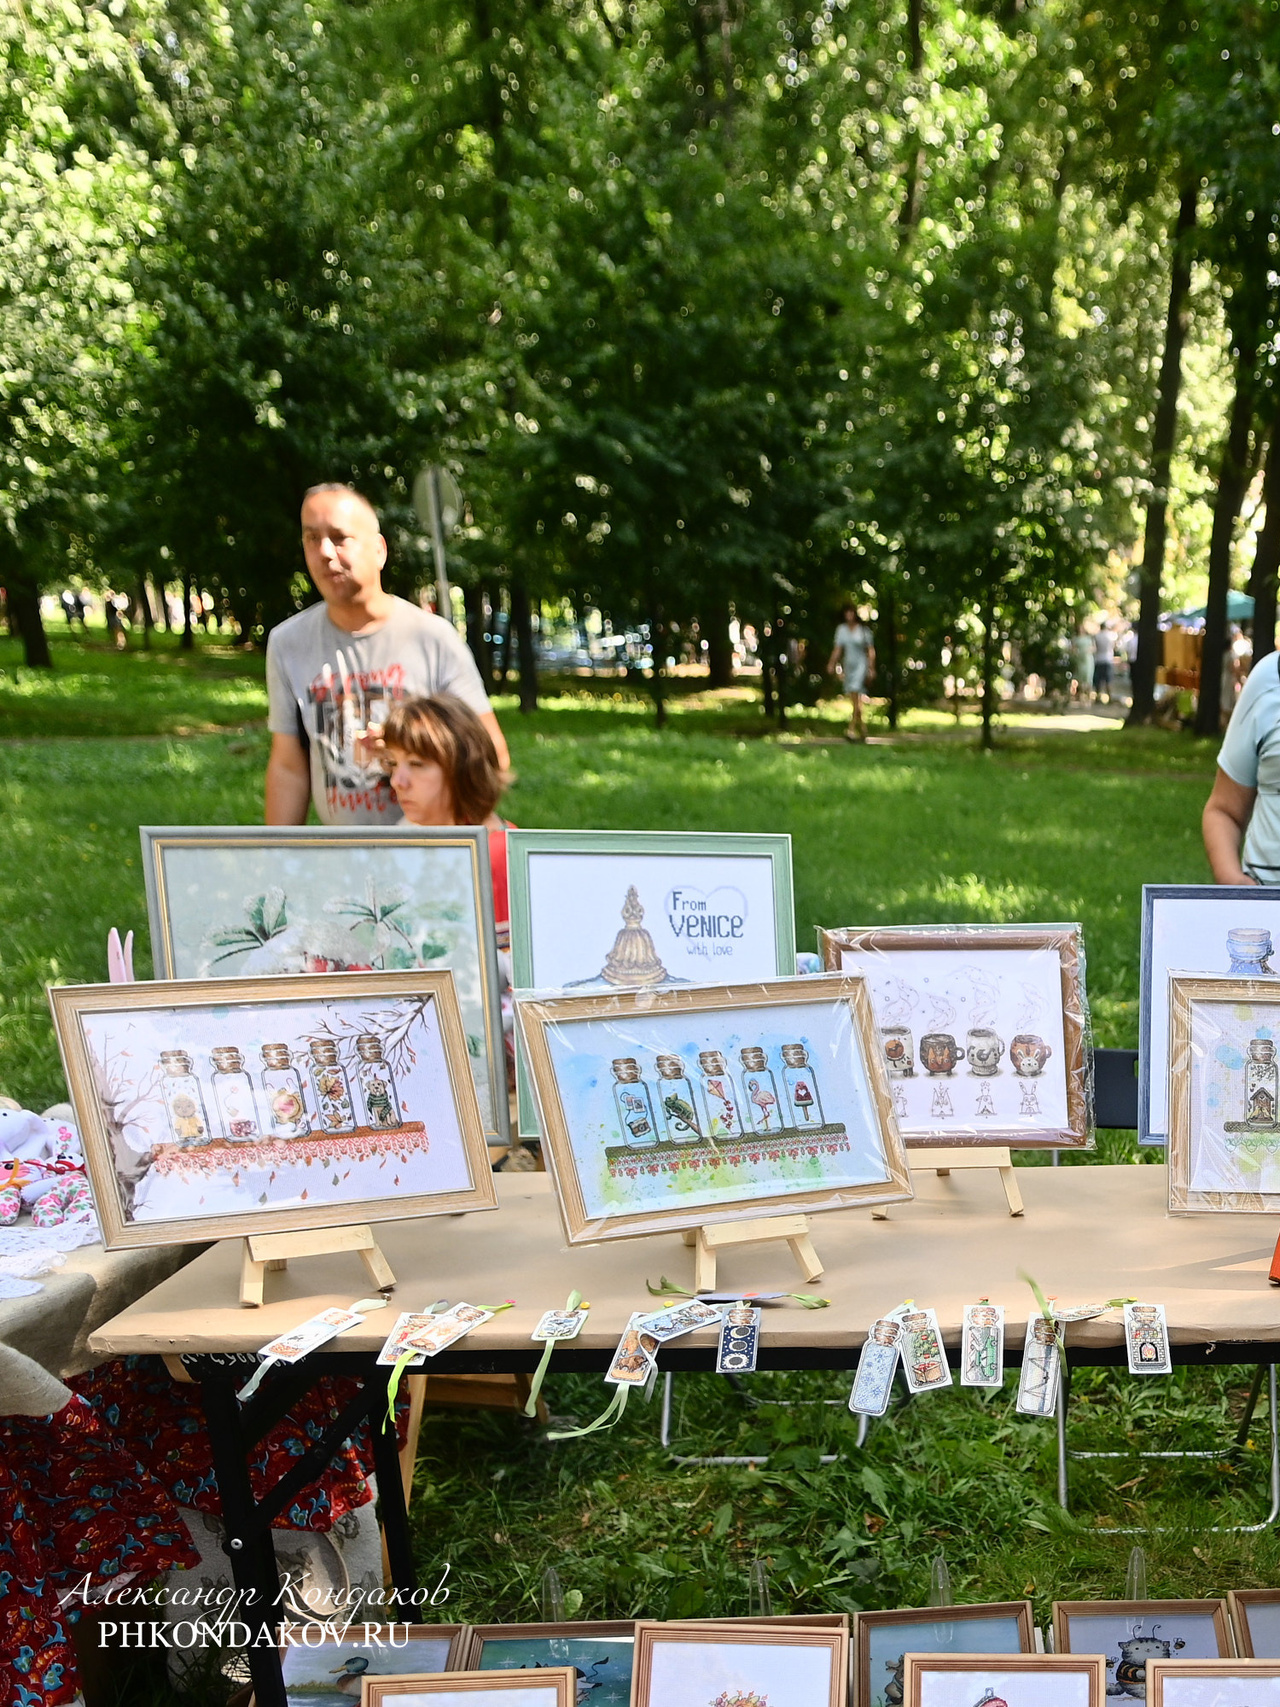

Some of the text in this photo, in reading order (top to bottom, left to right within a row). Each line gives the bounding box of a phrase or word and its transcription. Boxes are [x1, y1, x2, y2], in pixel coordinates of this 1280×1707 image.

[672, 891, 706, 911] From
[686, 942, 733, 955] with love
